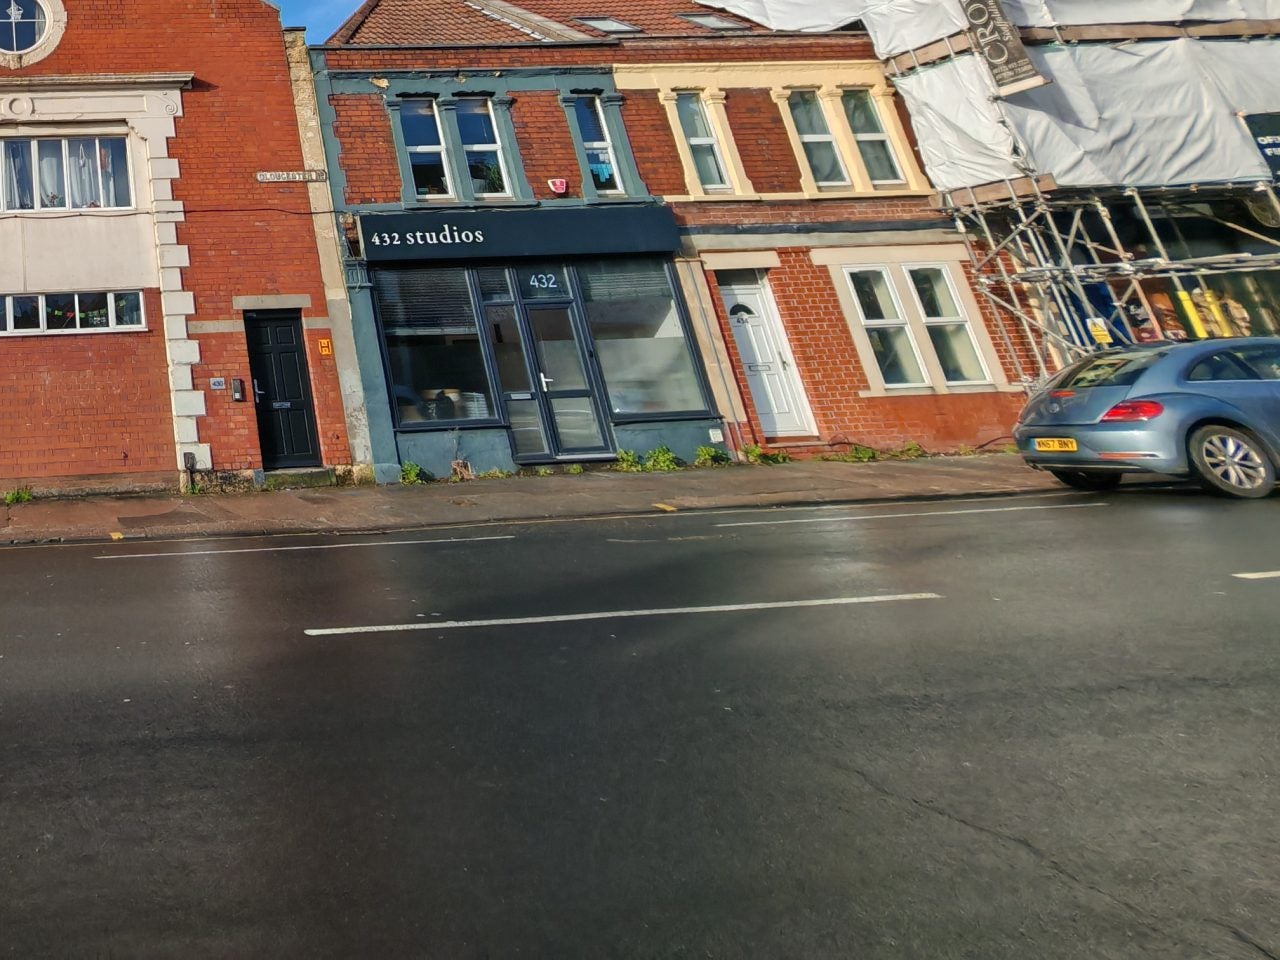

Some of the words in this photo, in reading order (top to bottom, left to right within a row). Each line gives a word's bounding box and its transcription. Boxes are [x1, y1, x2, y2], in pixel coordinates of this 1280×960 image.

[371, 232, 401, 246] 432
[406, 224, 484, 245] studios
[530, 273, 558, 288] 432
